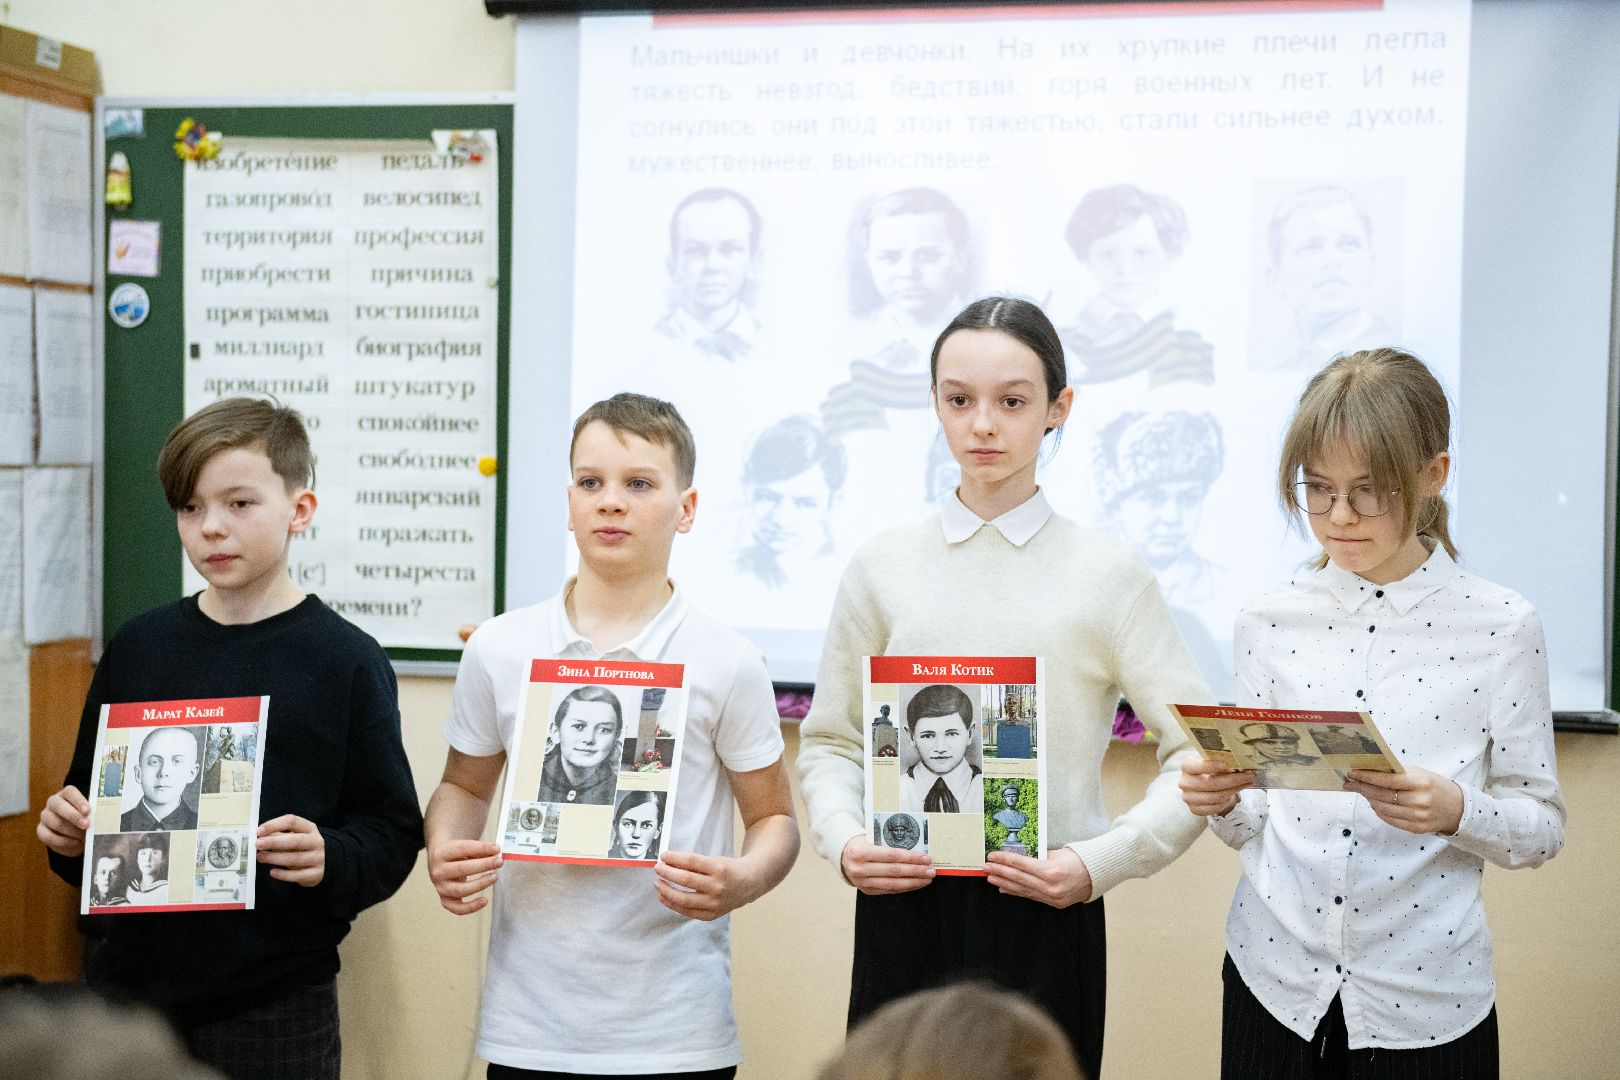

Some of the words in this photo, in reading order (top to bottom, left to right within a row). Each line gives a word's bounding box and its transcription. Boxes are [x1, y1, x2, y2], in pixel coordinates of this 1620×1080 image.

[631, 44, 779, 67] Мальчишки
[803, 47, 818, 64] и
[841, 42, 974, 65] девчонки.
[998, 37, 1034, 61] На
[1060, 39, 1091, 59] их
[1118, 36, 1226, 62] хрупкие
[1253, 32, 1336, 54] плечи
[1363, 28, 1447, 51] легла
[630, 82, 731, 102] тяжесть
[1048, 76, 1106, 99] горя
[1134, 72, 1253, 95] военных
[1280, 69, 1334, 90] лет.
[1361, 64, 1384, 90] И
[1411, 66, 1445, 88] не
[628, 118, 756, 142] согнулись
[772, 116, 818, 137] они
[830, 114, 878, 138] под
[894, 110, 951, 135] этой
[1119, 110, 1198, 131] стали
[1215, 106, 1330, 130] сильнее
[363, 190, 482, 209] велосипед
[203, 229, 333, 248] территория
[354, 227, 484, 249] профессия
[202, 264, 331, 287] приобрести
[370, 266, 473, 287] причина
[206, 306, 329, 326] программа
[355, 304, 480, 323] гостиница
[214, 340, 325, 360] миллиард
[356, 339, 482, 361] биография
[203, 376, 330, 397] ароматный
[354, 379, 475, 401] штукатур
[355, 487, 482, 510] январский
[359, 527, 475, 547] поражать
[355, 564, 475, 584] четыреста
